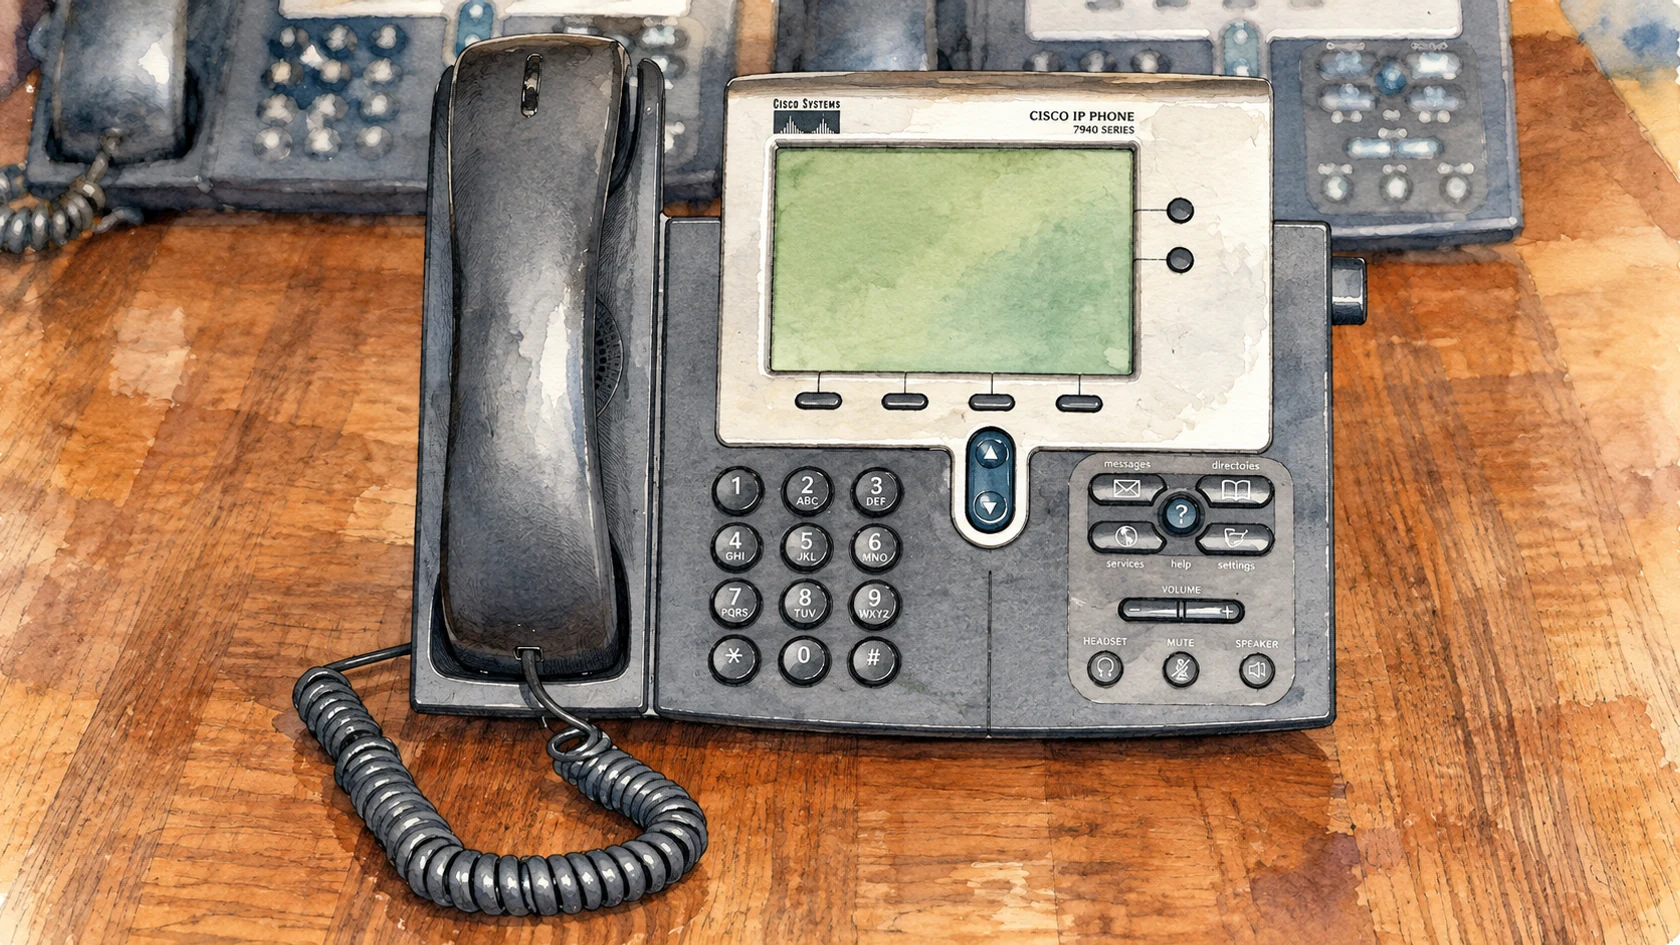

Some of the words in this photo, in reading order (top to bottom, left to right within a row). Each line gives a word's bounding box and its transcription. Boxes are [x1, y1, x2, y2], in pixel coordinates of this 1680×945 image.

[1029, 110, 1069, 122] CISCO
[1072, 111, 1086, 122] IP
[1089, 111, 1135, 122] PHONE
[1073, 125, 1099, 134] 7940
[1101, 125, 1135, 134] SERIES
[1104, 460, 1152, 471] messages
[731, 476, 741, 494] 1
[801, 476, 814, 494] 2
[870, 477, 883, 494] 3
[796, 497, 819, 506] ABC
[866, 497, 886, 506] DEF
[729, 532, 742, 549] 4
[801, 532, 813, 549] 5
[868, 533, 882, 551] 6
[725, 552, 745, 561] GHI
[797, 552, 817, 561] JKL
[862, 552, 888, 562] MNO
[1106, 560, 1145, 569] services
[1170, 559, 1192, 570] help
[1217, 560, 1256, 571] settings
[1162, 585, 1202, 594] VOLUME
[729, 588, 742, 606] 7
[799, 588, 812, 606] 8
[868, 589, 881, 607] 9
[721, 608, 749, 617] PQRS
[794, 608, 816, 618] TUV
[1083, 636, 1128, 646] HEADSET
[1166, 638, 1195, 647] MUTE
[1235, 639, 1279, 649] SPEAKER
[797, 646, 811, 663] 0
